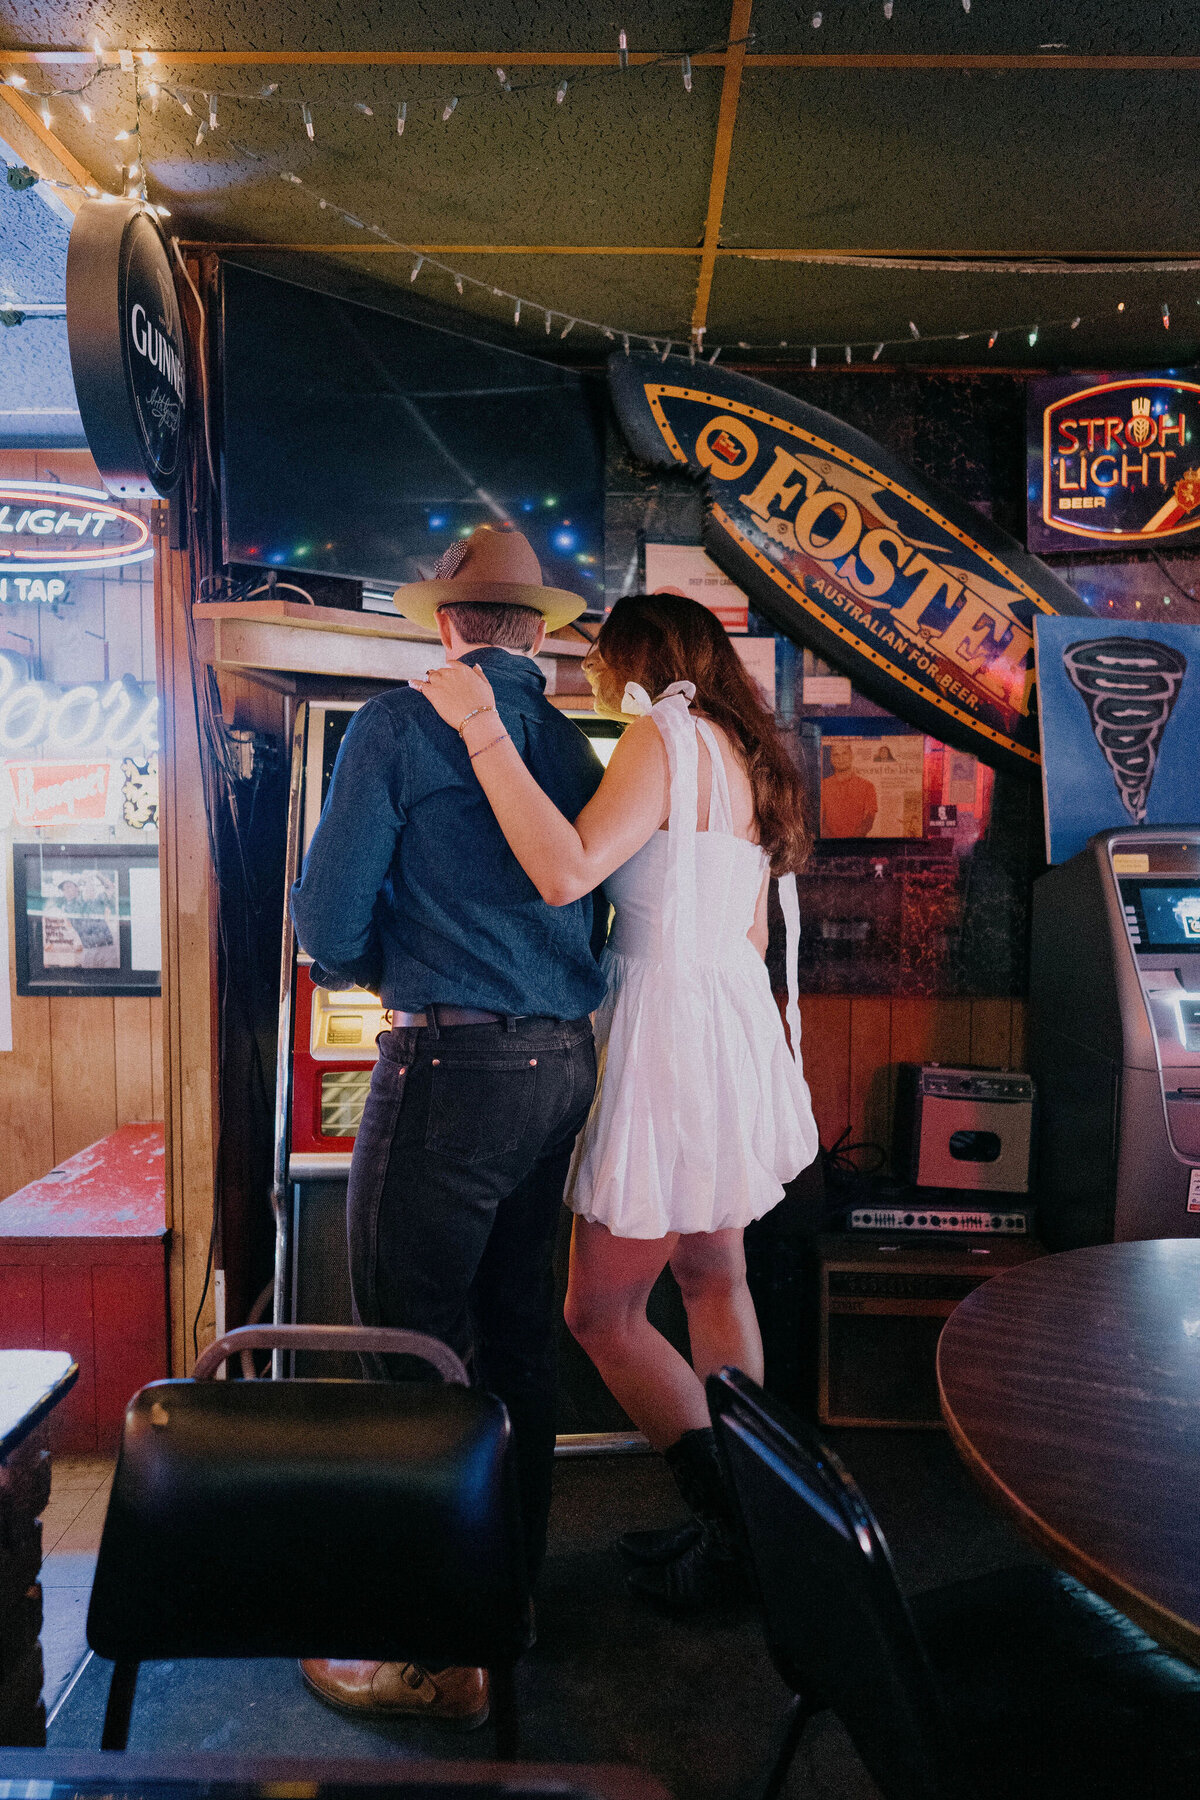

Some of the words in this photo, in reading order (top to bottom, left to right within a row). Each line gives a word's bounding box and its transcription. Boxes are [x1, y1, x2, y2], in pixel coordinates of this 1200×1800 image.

[1058, 413, 1186, 455] STROH
[1059, 451, 1177, 490] LIGHT
[1058, 496, 1106, 510] BEER
[0, 505, 118, 537] LIGHT
[13, 577, 66, 603] TAP
[812, 578, 910, 655] AUSTRALIAN
[908, 650, 939, 676] FOR
[940, 674, 980, 711] BEER.
